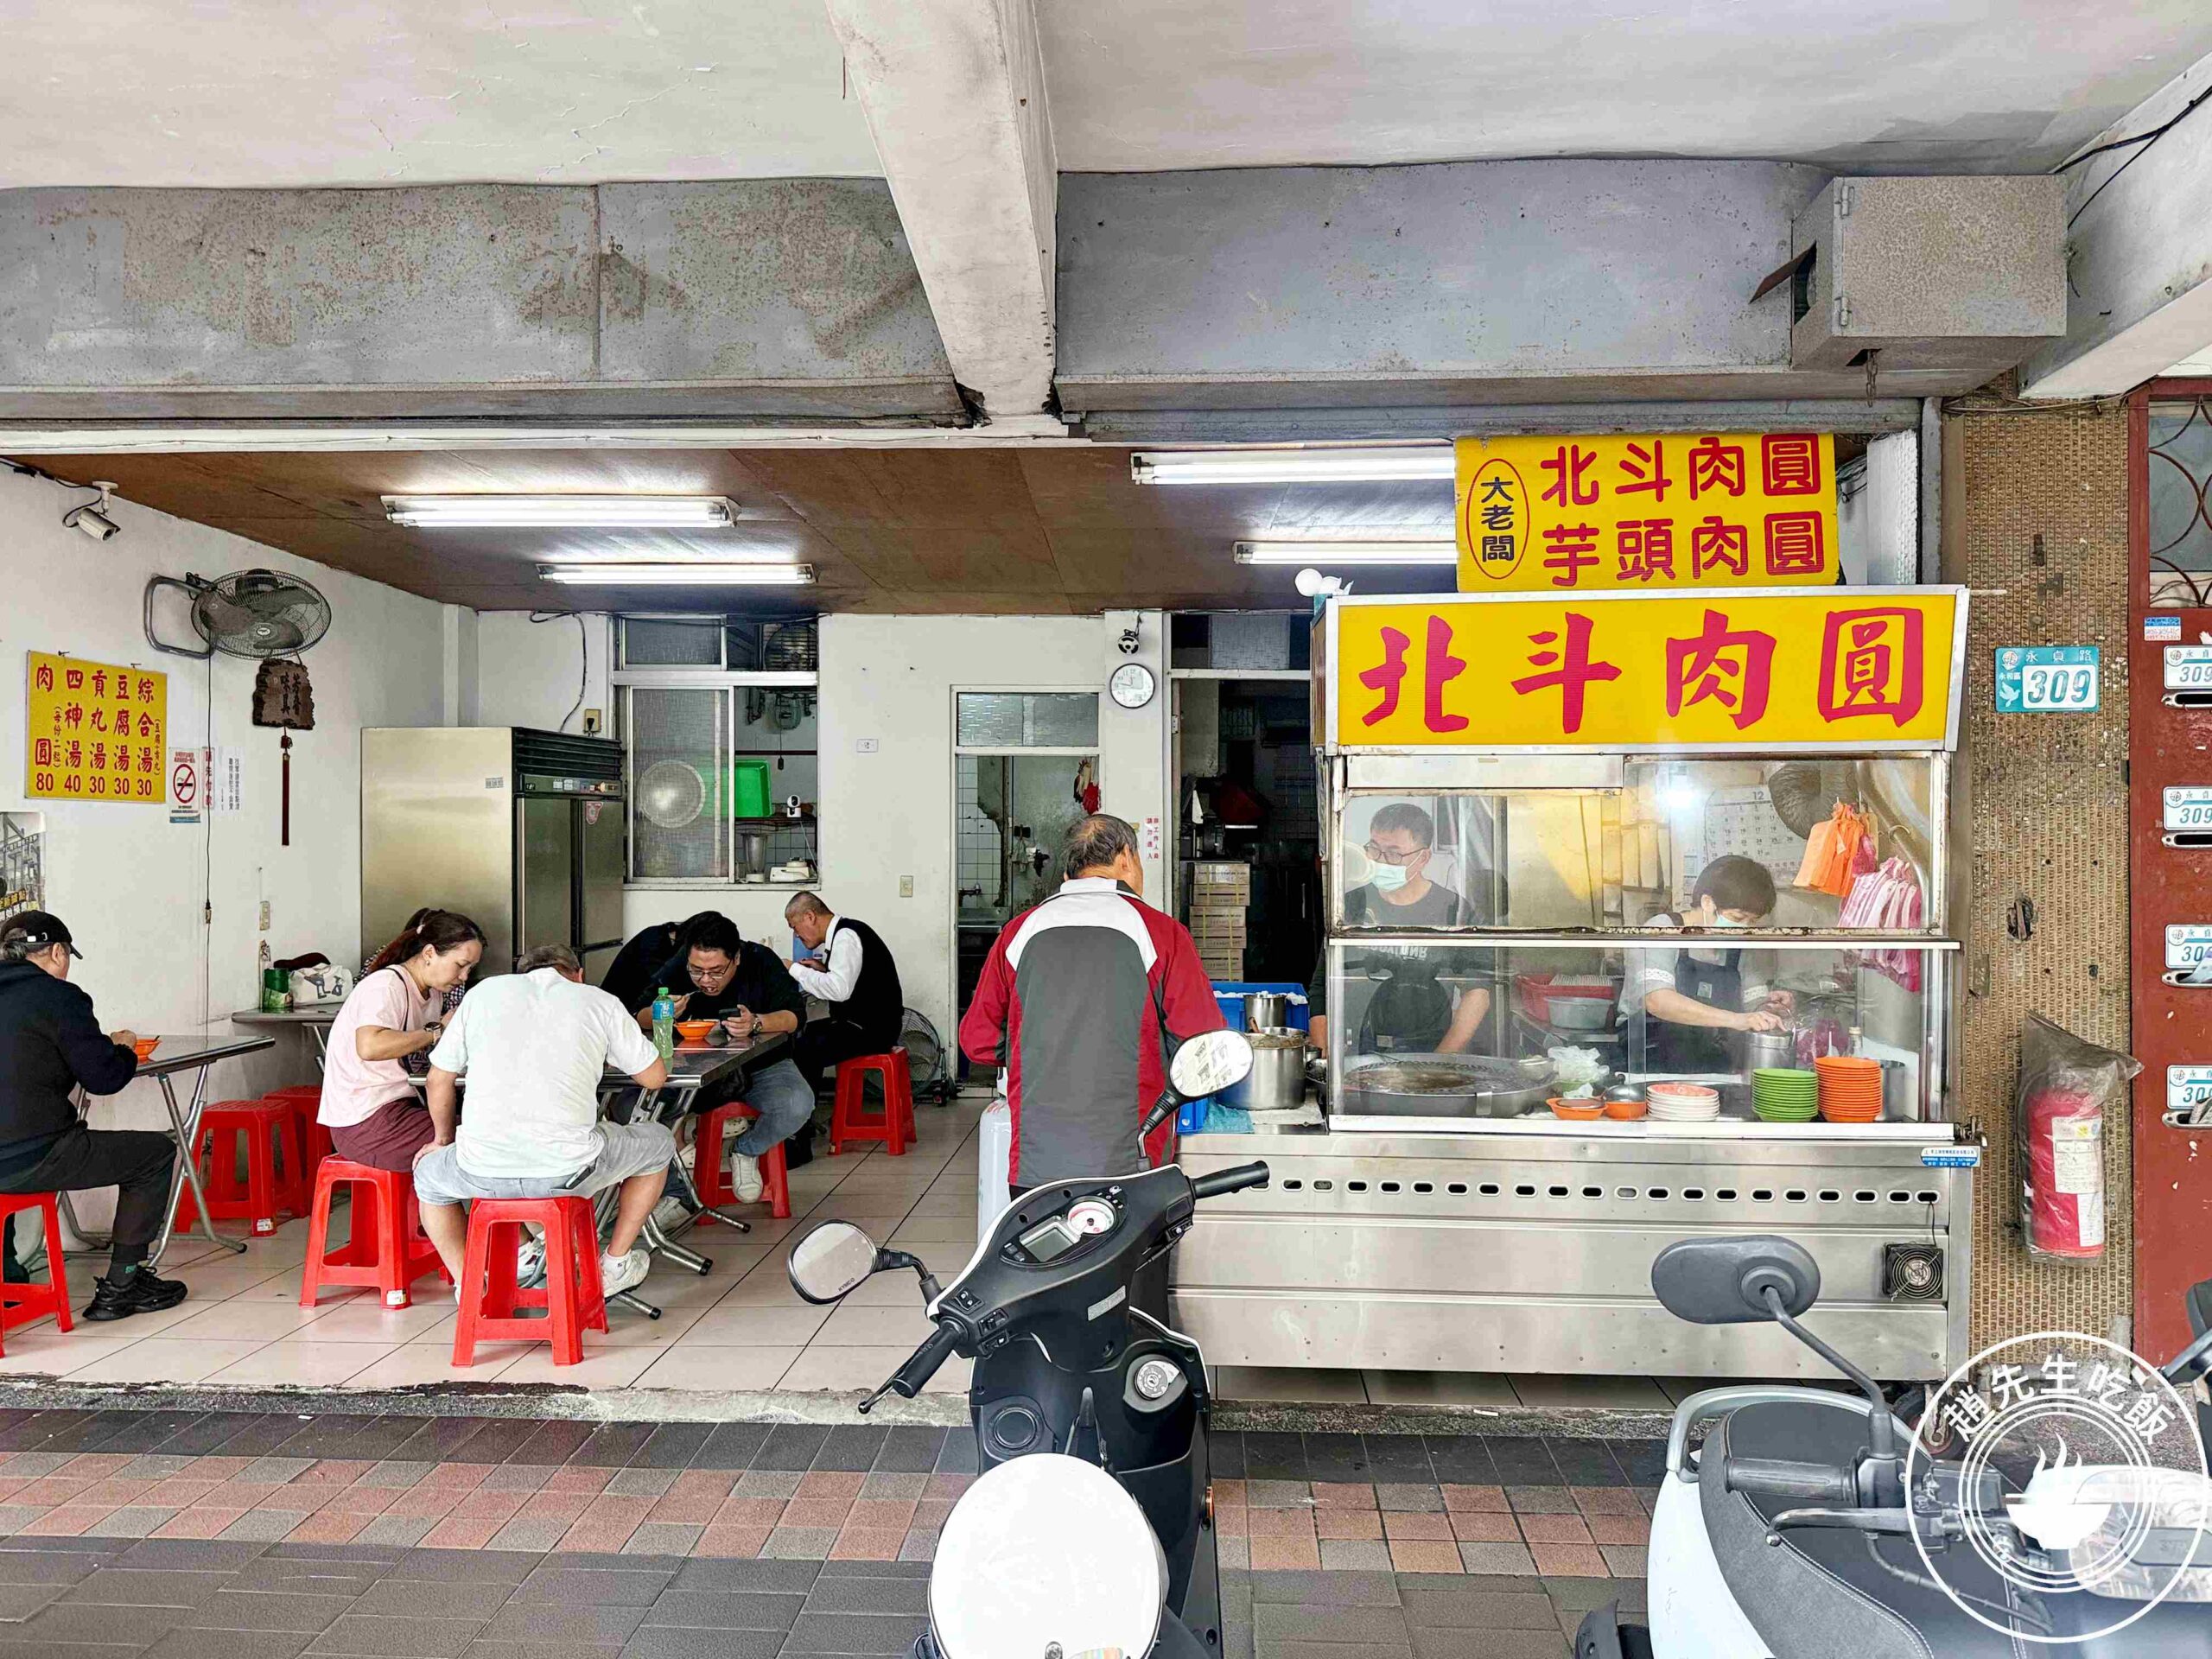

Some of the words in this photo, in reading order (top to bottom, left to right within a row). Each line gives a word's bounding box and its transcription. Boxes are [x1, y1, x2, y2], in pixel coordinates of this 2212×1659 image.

[1541, 433, 1821, 508] 北斗肉圓
[1480, 476, 1515, 563] 大老闆
[1541, 511, 1825, 587] 芋頭肉圓
[1358, 607, 1923, 734] 北斗肉圓
[2025, 649, 2092, 663] 永貞路
[2027, 670, 2091, 703] 309
[64, 669, 84, 769] 四神湯
[90, 670, 108, 770] 貢丸湯
[113, 674, 130, 772] 豆腐湯
[137, 677, 155, 773] 綜合湯
[36, 772, 54, 792] 80
[64, 774, 81, 793] 40
[89, 776, 105, 794] 30
[114, 777, 130, 795] 30
[137, 779, 152, 796] 30
[1752, 791, 1764, 800] 12
[2181, 945, 2212, 962] 30
